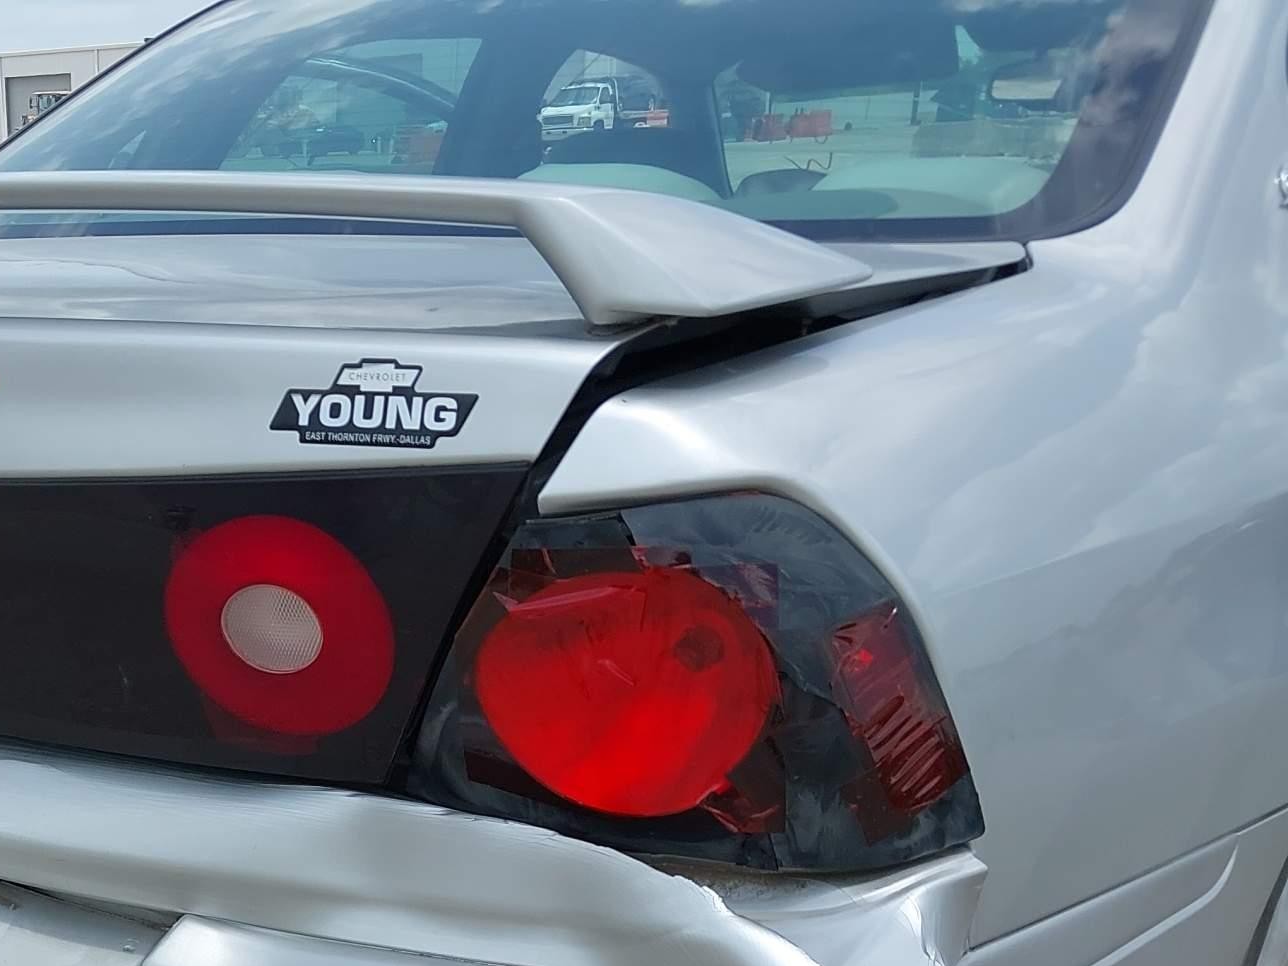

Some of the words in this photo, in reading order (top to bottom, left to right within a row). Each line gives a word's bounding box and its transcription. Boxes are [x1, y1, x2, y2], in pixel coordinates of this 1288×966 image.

[348, 371, 407, 382] CHEVROLET
[291, 394, 458, 431] YOUNG
[305, 431, 325, 440] EAST
[327, 432, 371, 443] THORNTON
